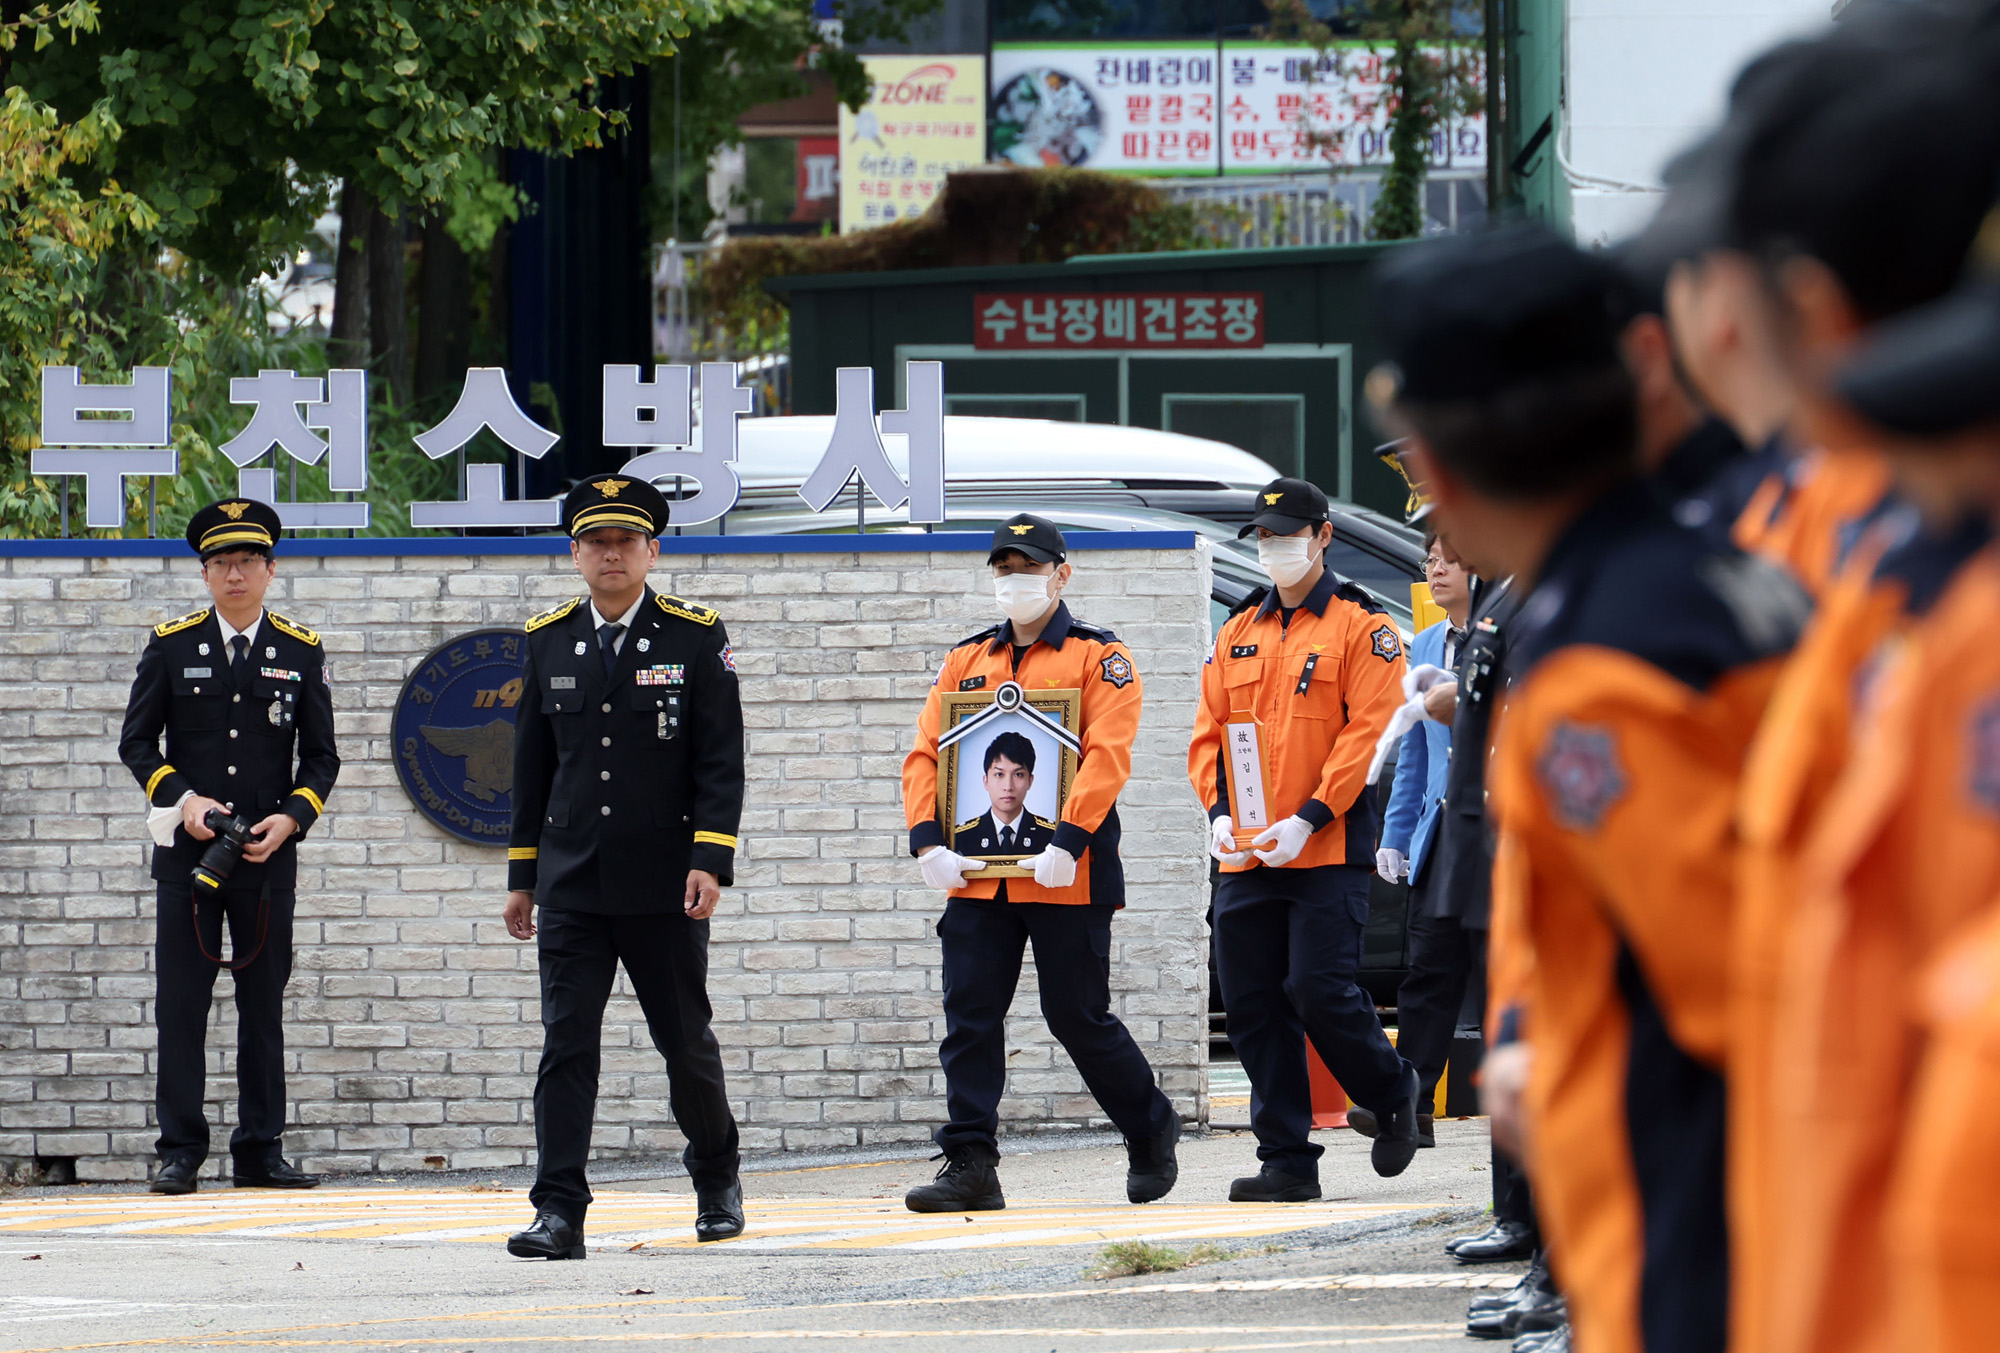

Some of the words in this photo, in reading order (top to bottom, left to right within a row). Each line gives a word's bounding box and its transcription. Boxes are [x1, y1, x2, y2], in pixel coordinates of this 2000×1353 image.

[1122, 130, 1212, 161] 따끈한
[982, 297, 1258, 343] 수난장비건조장
[30, 360, 946, 530] 부천소방서
[1237, 731, 1249, 743] 故
